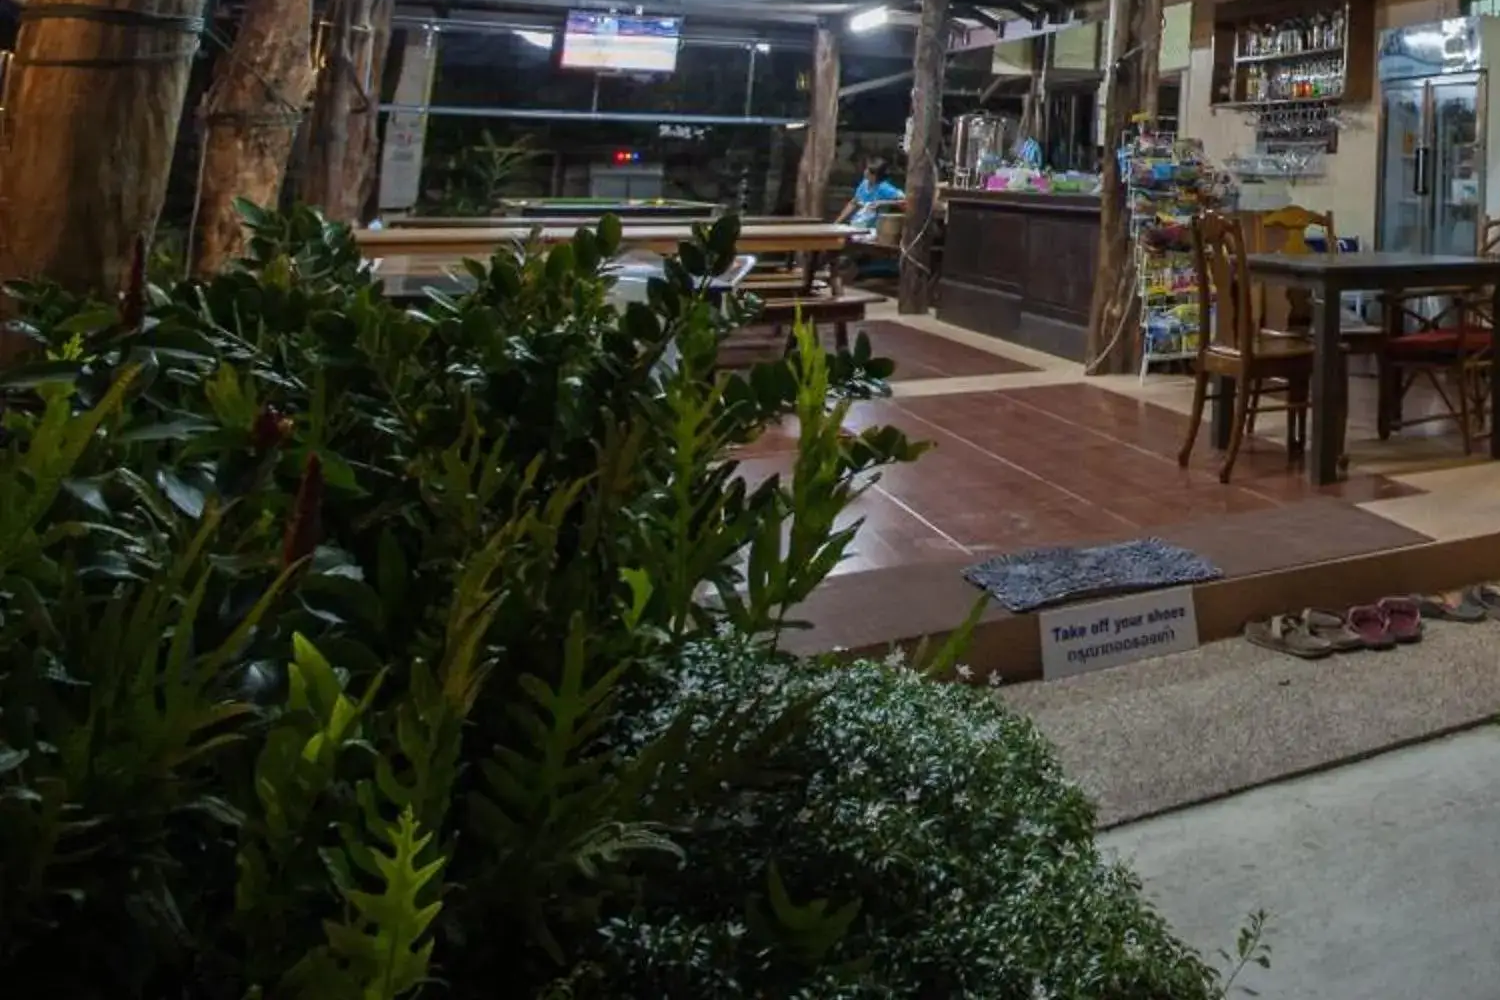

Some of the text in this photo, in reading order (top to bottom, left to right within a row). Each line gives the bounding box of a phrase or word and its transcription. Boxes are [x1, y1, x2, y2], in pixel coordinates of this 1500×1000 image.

[1052, 606, 1186, 642] Take off your shoes
